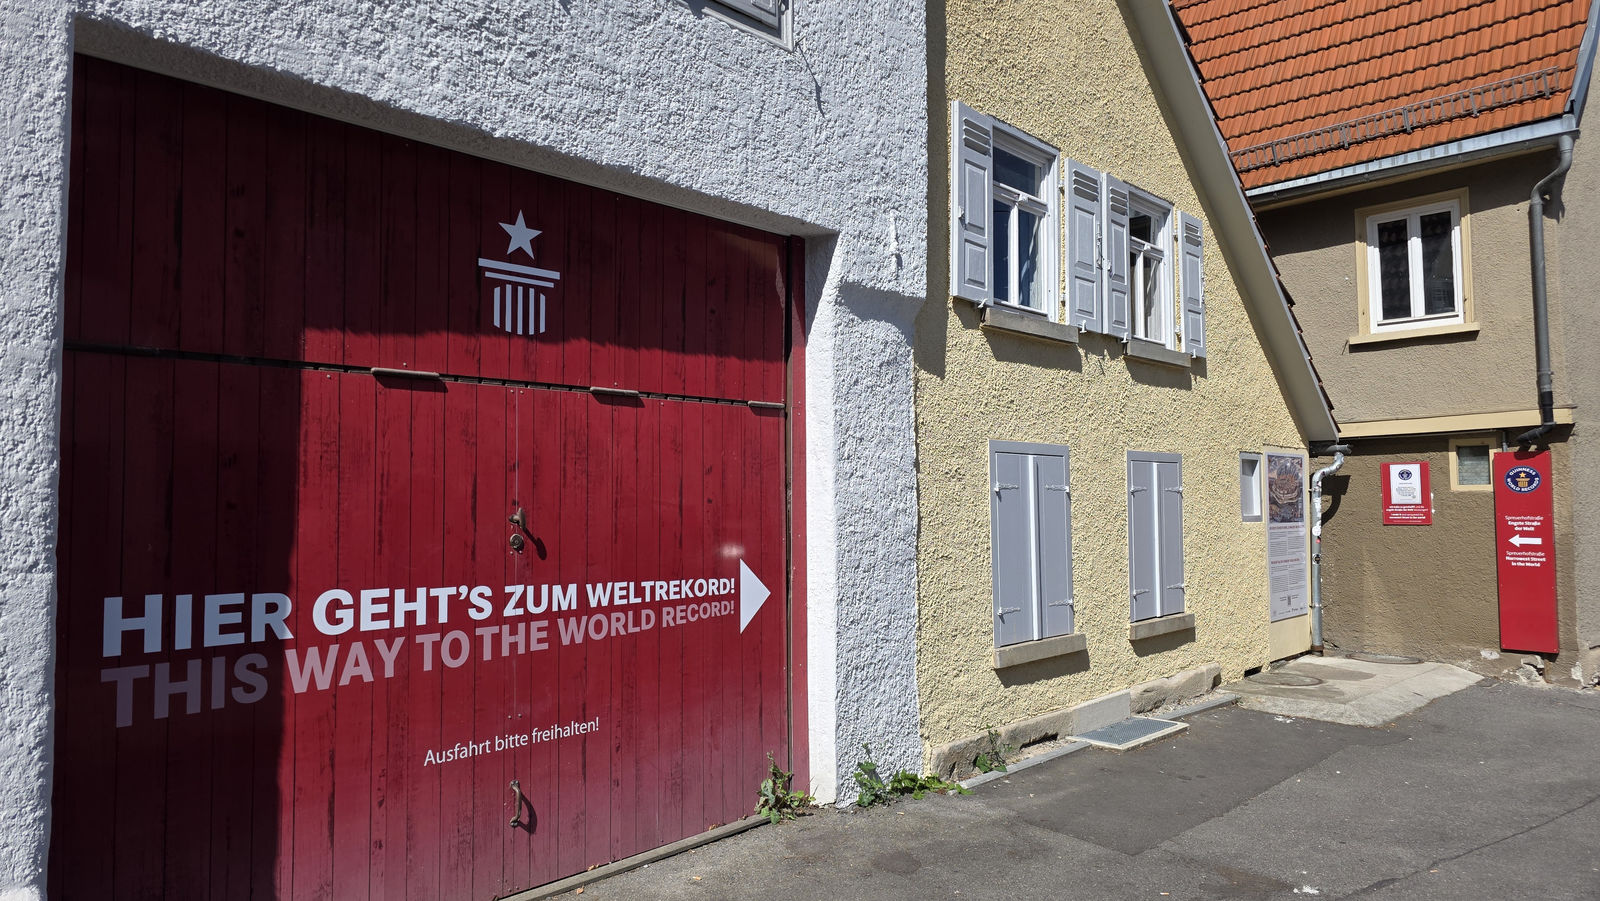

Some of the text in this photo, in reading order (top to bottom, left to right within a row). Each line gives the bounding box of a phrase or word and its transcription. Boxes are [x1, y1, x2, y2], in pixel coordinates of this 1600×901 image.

[102, 592, 294, 658] HIER
[503, 583, 577, 617] ZUM
[586, 578, 736, 608] WELTREKORD!
[100, 600, 736, 728] THIS WAY TO THE WORLD RECORD!
[423, 716, 600, 766] Ausfahrt bitte freihalten!
